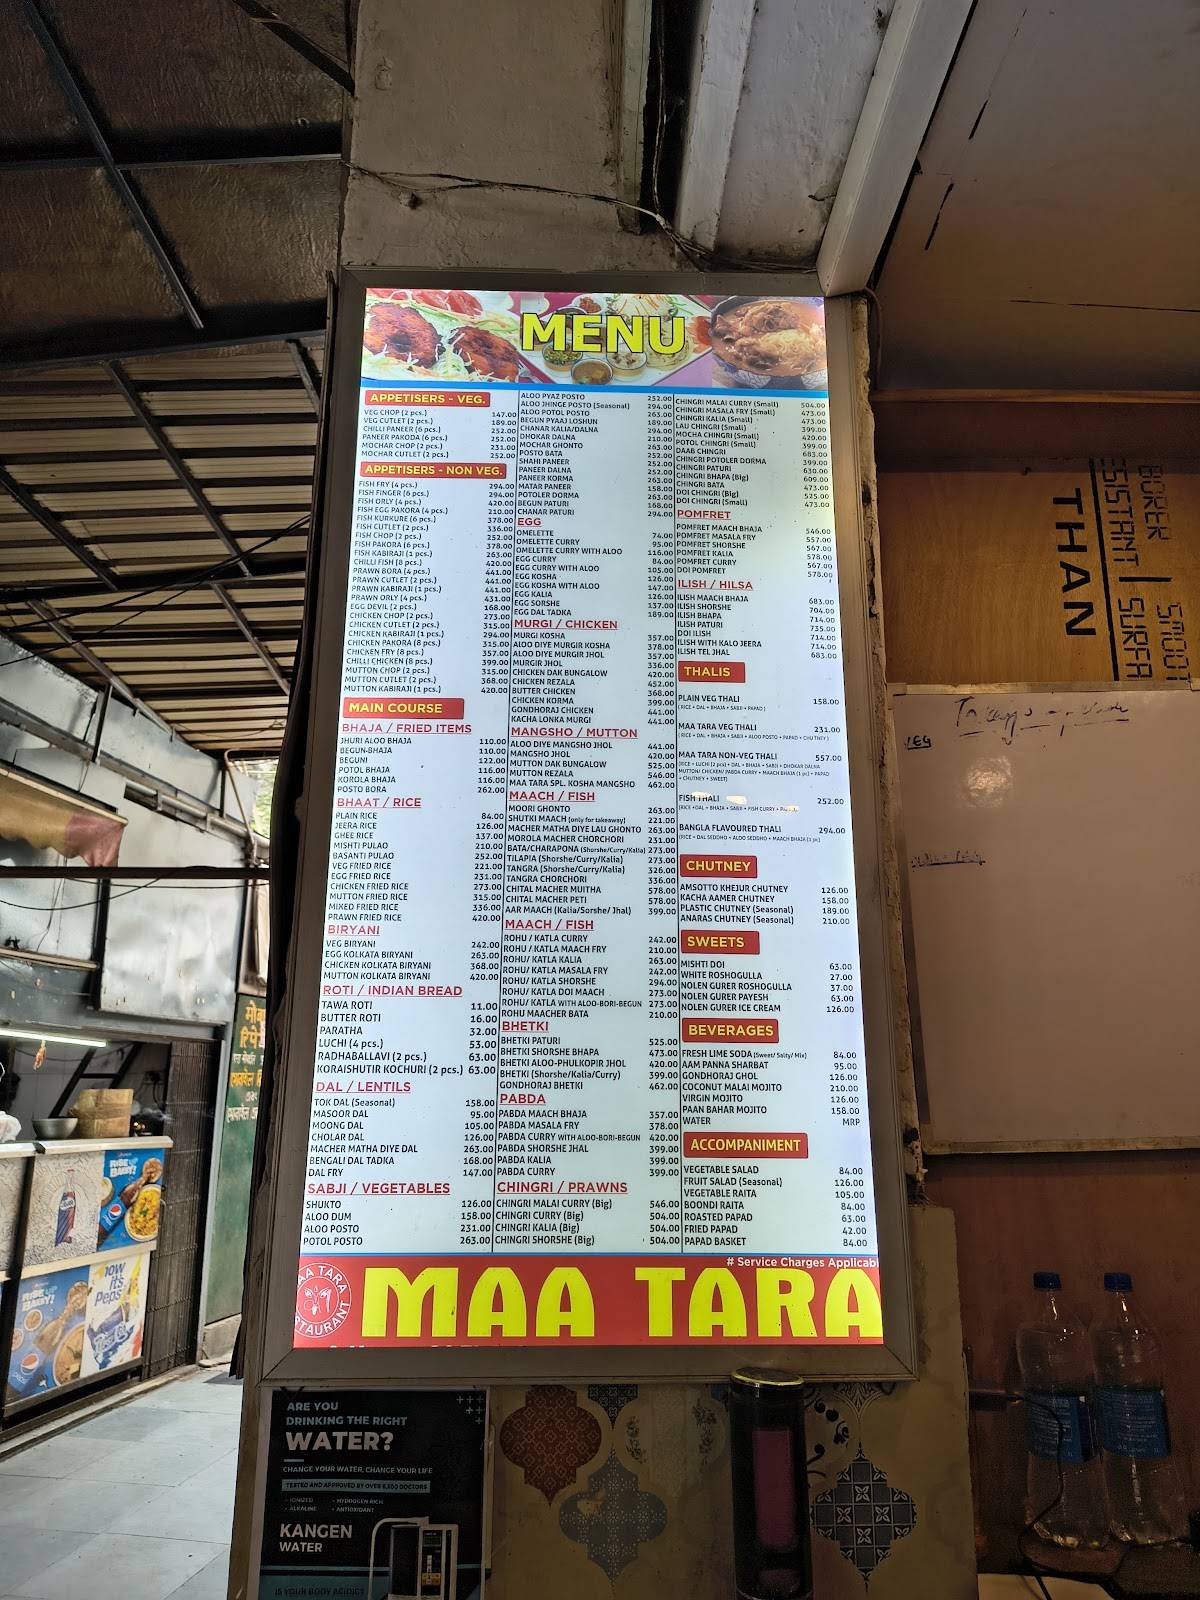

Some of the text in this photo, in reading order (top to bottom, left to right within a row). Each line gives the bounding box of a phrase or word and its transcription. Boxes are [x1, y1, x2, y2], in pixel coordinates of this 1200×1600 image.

[521, 312, 686, 354] MENU
[370, 394, 445, 403] APPETISERS
[457, 395, 485, 404] VEG.
[364, 466, 435, 475] APPETISERS
[447, 467, 472, 475] NON
[476, 467, 503, 475] VEG.
[677, 510, 731, 518] POMFRET
[1052, 487, 1097, 637] THAN
[678, 580, 707, 588] ILISH
[720, 581, 753, 589] HILSA
[514, 620, 552, 628] MURGI
[565, 620, 617, 628] CHICKEN
[1118, 597, 1153, 678] SURFA
[684, 666, 731, 676] THALIS
[349, 703, 442, 713] MAIN COURSE
[341, 724, 383, 732] BHAJA
[396, 724, 432, 733] FRIED
[436, 724, 471, 733] ITEMS
[512, 728, 573, 737] MANGSHO
[587, 729, 638, 737] MUTTON
[509, 769, 543, 777] MUTTON
[509, 792, 554, 800] MAACH
[568, 792, 595, 801] FISH
[337, 798, 380, 807] BHAAT
[393, 798, 422, 807] RICE
[686, 861, 751, 871] CHUTNEY
[505, 920, 552, 929] MAACH
[566, 920, 594, 929] FISH
[328, 925, 380, 935] BIRYANI
[687, 936, 745, 947] SWEETS
[323, 985, 354, 995] ROTI
[368, 986, 413, 995] INDIAN
[418, 986, 463, 995] BREAD
[319, 1026, 497, 1036] PARATHA 32.00
[502, 1022, 549, 1031] BHETKI
[688, 1025, 774, 1036] BEVERAGES
[316, 1082, 343, 1091] DAL
[358, 1082, 411, 1091] LENTILS
[500, 1094, 545, 1104] PABDA
[313, 1110, 350, 1118] MASOOR
[683, 1117, 711, 1125] WATER
[691, 1139, 801, 1151] ACCOMPANIMENT
[497, 1156, 525, 1164] PABDA
[649, 1157, 679, 1165] 399.00
[308, 1183, 346, 1194] SABJI
[363, 1183, 450, 1194] VEGETABLES
[497, 1182, 553, 1192] CHINGRI
[568, 1182, 628, 1193] PRAWNS
[306, 1200, 492, 1209] SHUKTO 126.00
[685, 1237, 867, 1247] PAPAD BASKET 84.00
[738, 1258, 777, 1267] Service
[781, 1258, 824, 1268] Charges
[297, 1266, 348, 1294] AA TARA
[362, 1266, 883, 1338] MAA TARA
[287, 1401, 338, 1411] ARE YOU
[286, 1416, 407, 1426] DRINKING THE RIGHT
[285, 1431, 394, 1451] WATER?
[279, 1523, 352, 1539] KANGEN
[279, 1541, 322, 1553] WATER
